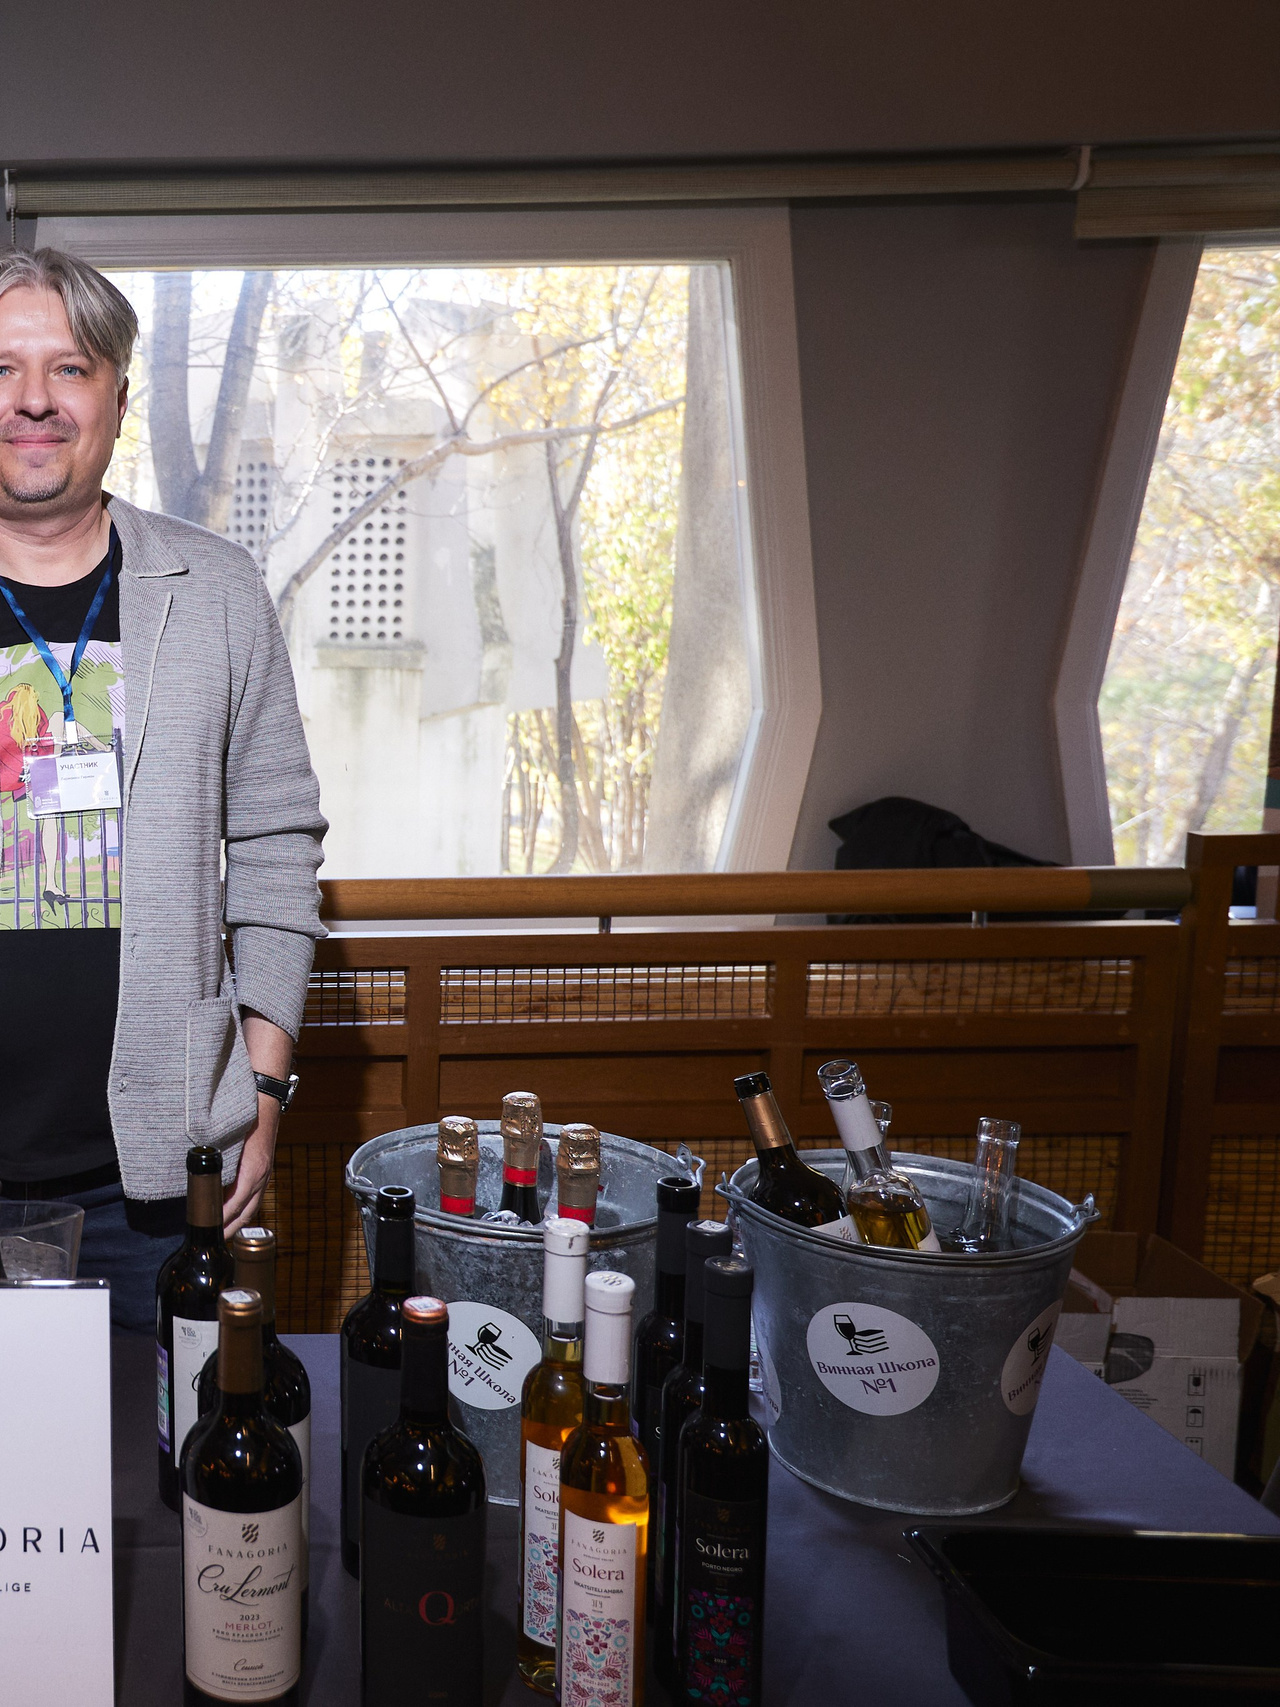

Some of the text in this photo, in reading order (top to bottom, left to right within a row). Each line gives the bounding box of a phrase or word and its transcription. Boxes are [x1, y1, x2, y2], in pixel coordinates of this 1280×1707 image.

[60, 762, 99, 770] УЧАСТНИК
[816, 1357, 936, 1375] Винная Школа
[474, 1366, 516, 1403] Школа
[860, 1378, 897, 1394] №1
[208, 1543, 288, 1558] FANAGORIA
[571, 1539, 627, 1555] FANAGORIA
[695, 1537, 750, 1560] Solera
[572, 1557, 624, 1581] Solera
[701, 1561, 743, 1573] PORTO NEGRO
[197, 1563, 296, 1607] Cru Lermont
[225, 1621, 273, 1631] MERLOT
